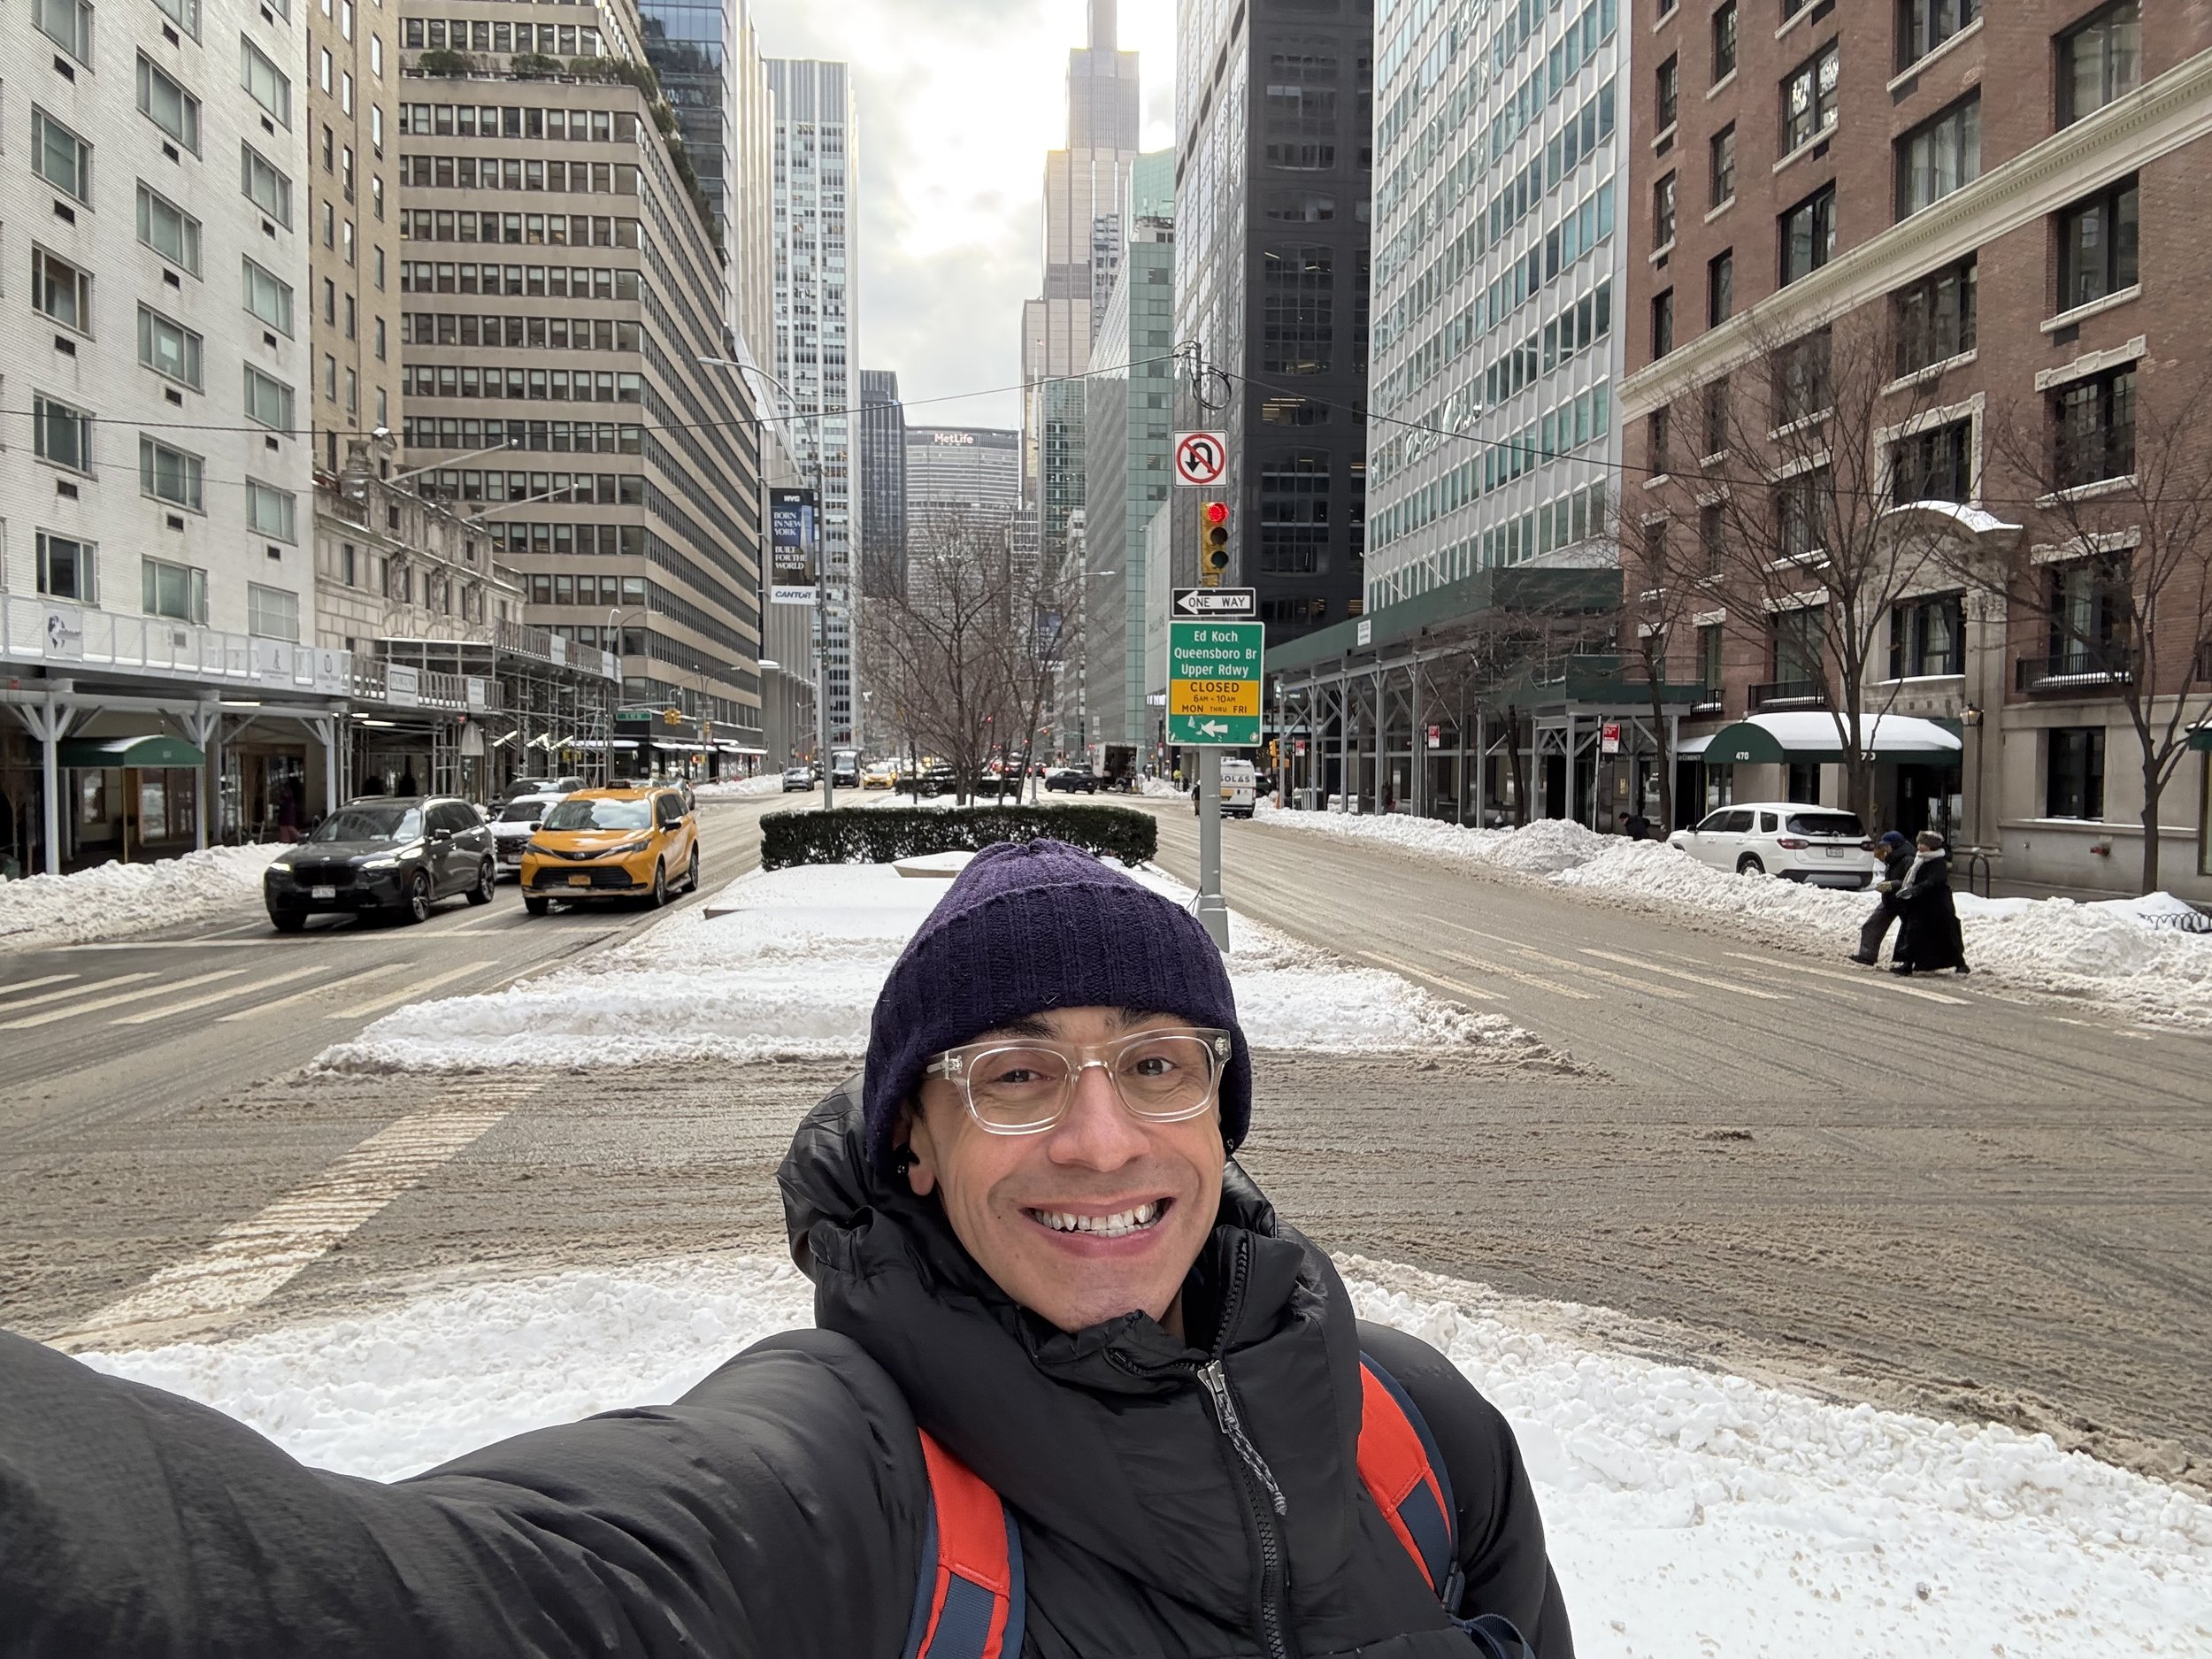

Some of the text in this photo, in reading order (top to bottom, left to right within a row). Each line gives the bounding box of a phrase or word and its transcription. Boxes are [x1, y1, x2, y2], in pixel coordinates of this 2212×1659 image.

[934, 433, 973, 443] MetLife
[1188, 597, 1245, 607] ONE WAY
[1194, 631, 1238, 641] Ed Koch
[1174, 648, 1256, 660] Queensboro Br
[1181, 664, 1249, 678] Upper Rdwy
[1190, 681, 1240, 693] CLOSED
[1735, 751, 1749, 761] 470
